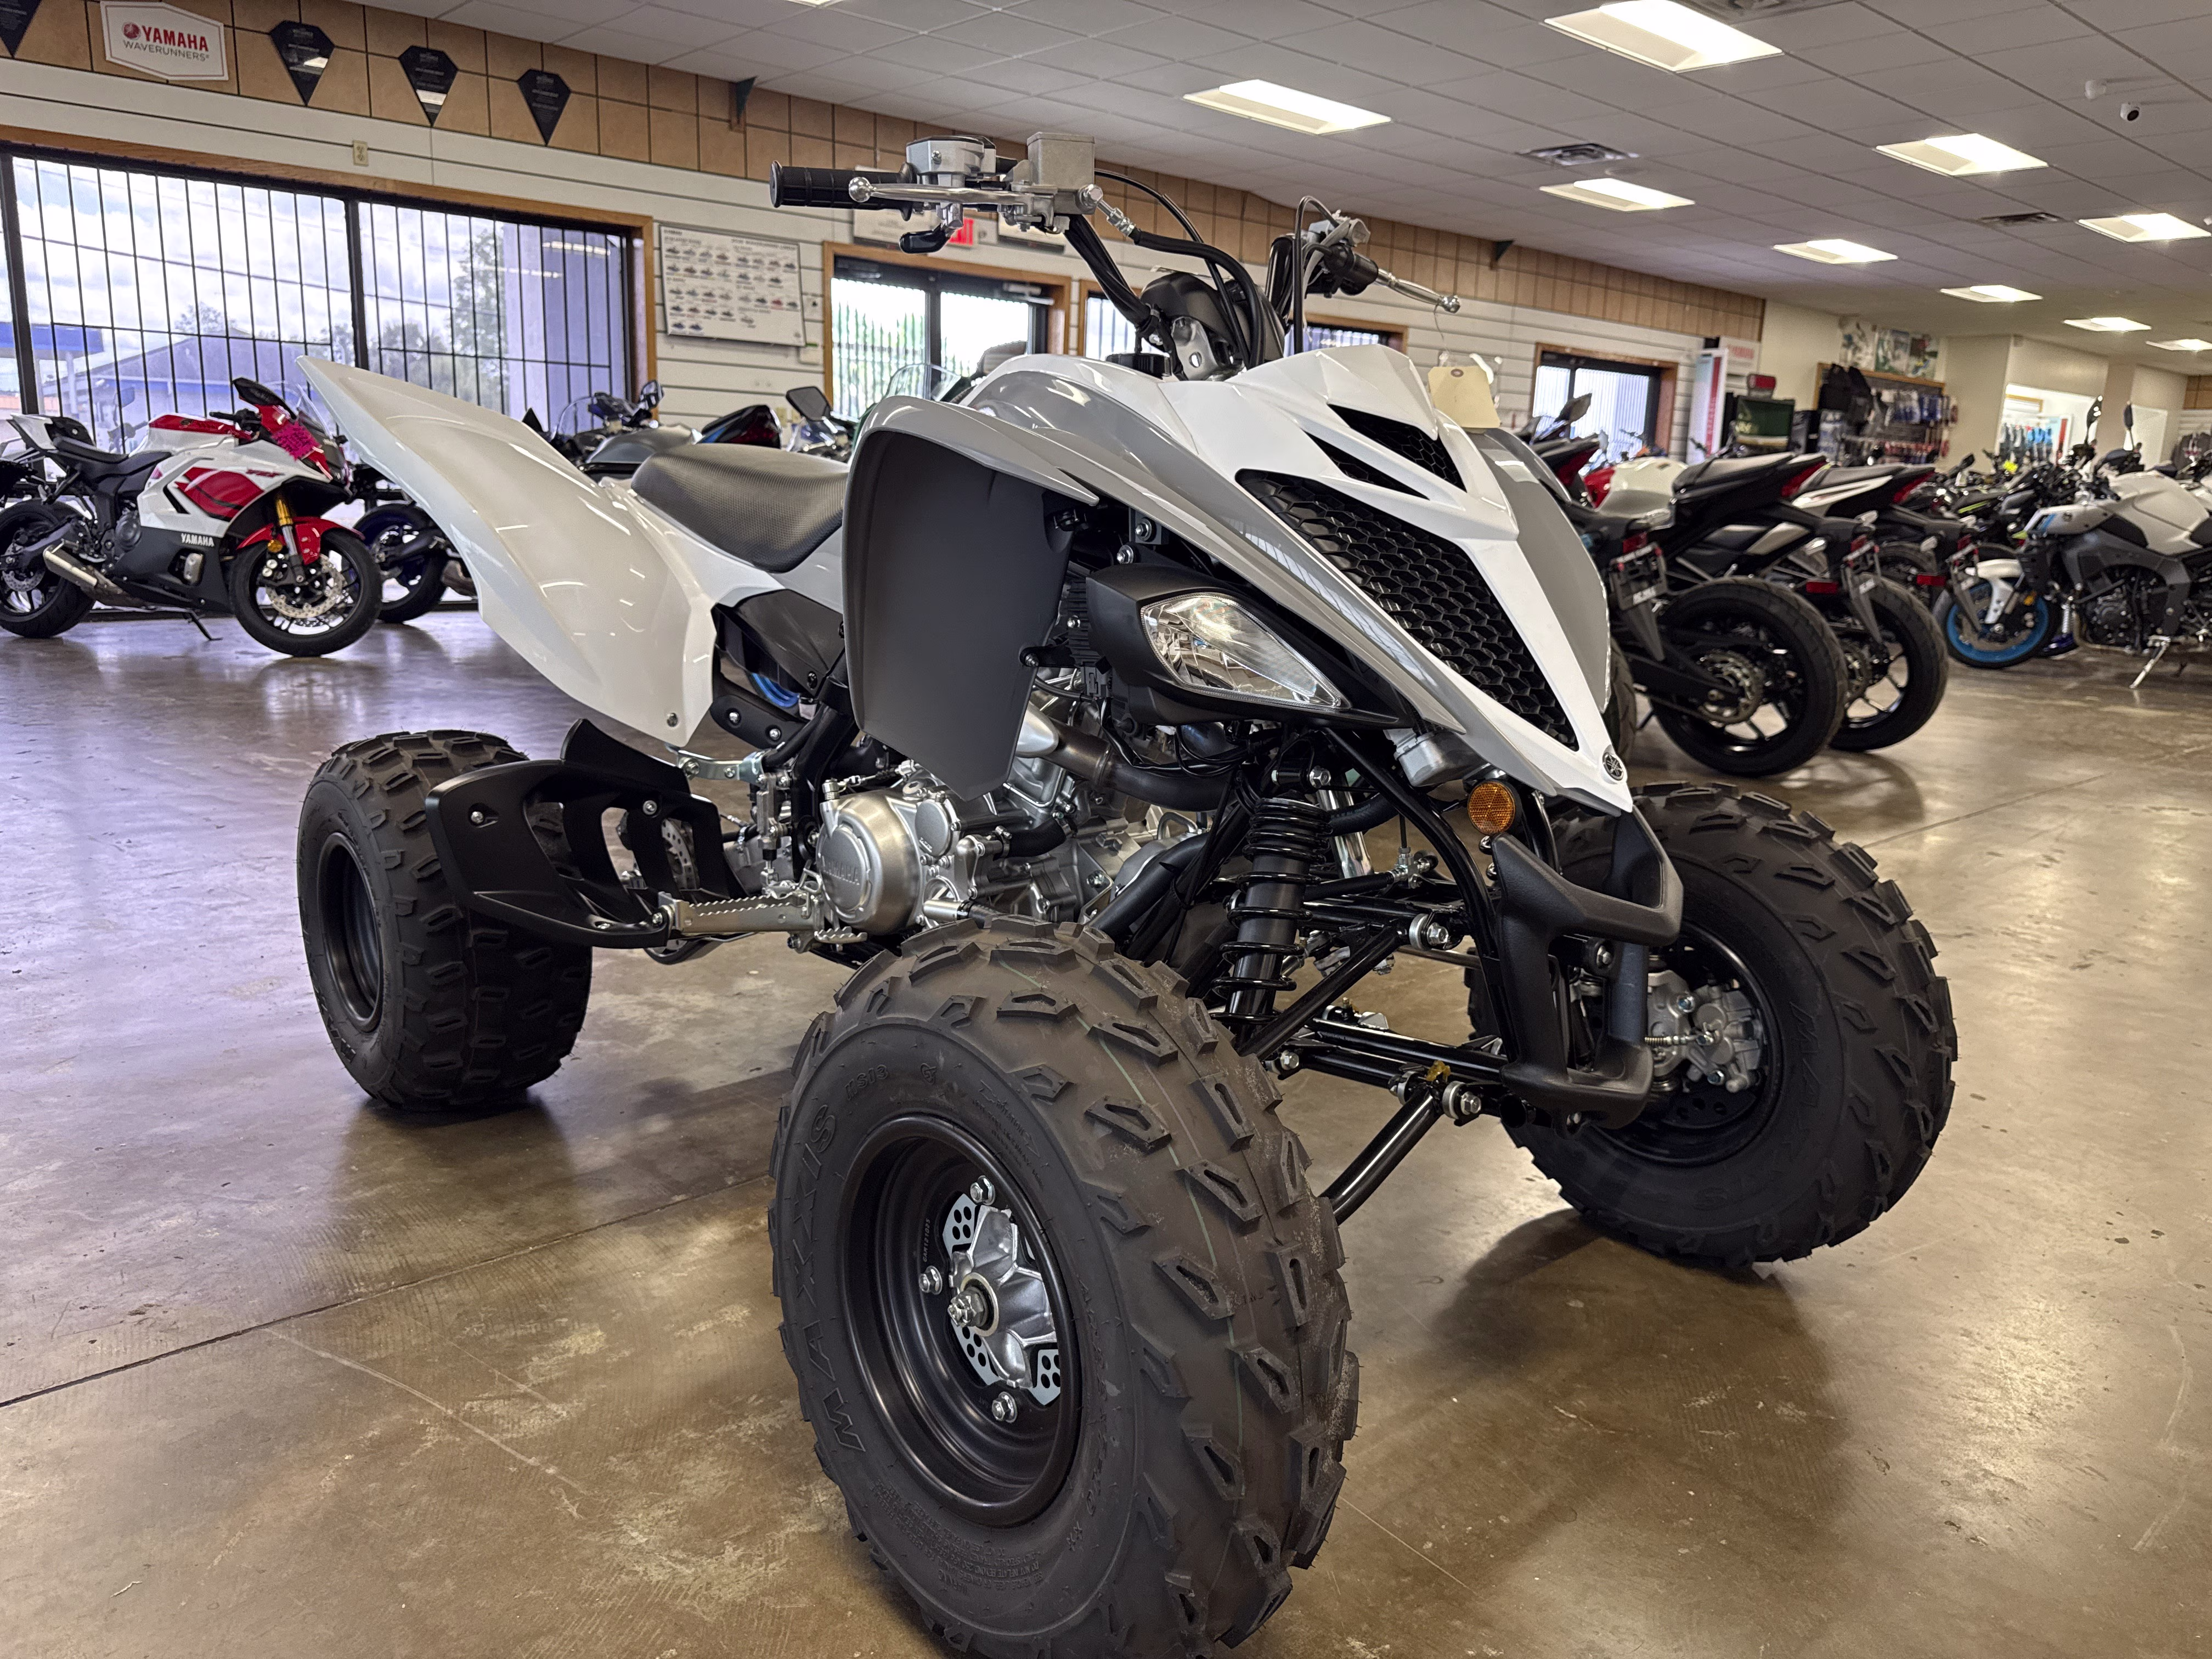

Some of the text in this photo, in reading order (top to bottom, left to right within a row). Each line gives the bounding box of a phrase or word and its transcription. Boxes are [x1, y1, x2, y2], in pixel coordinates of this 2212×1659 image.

[142, 25, 208, 52] YAMAHA
[181, 533, 215, 547] YAMAHA
[792, 1104, 866, 1453] MAXXIS
